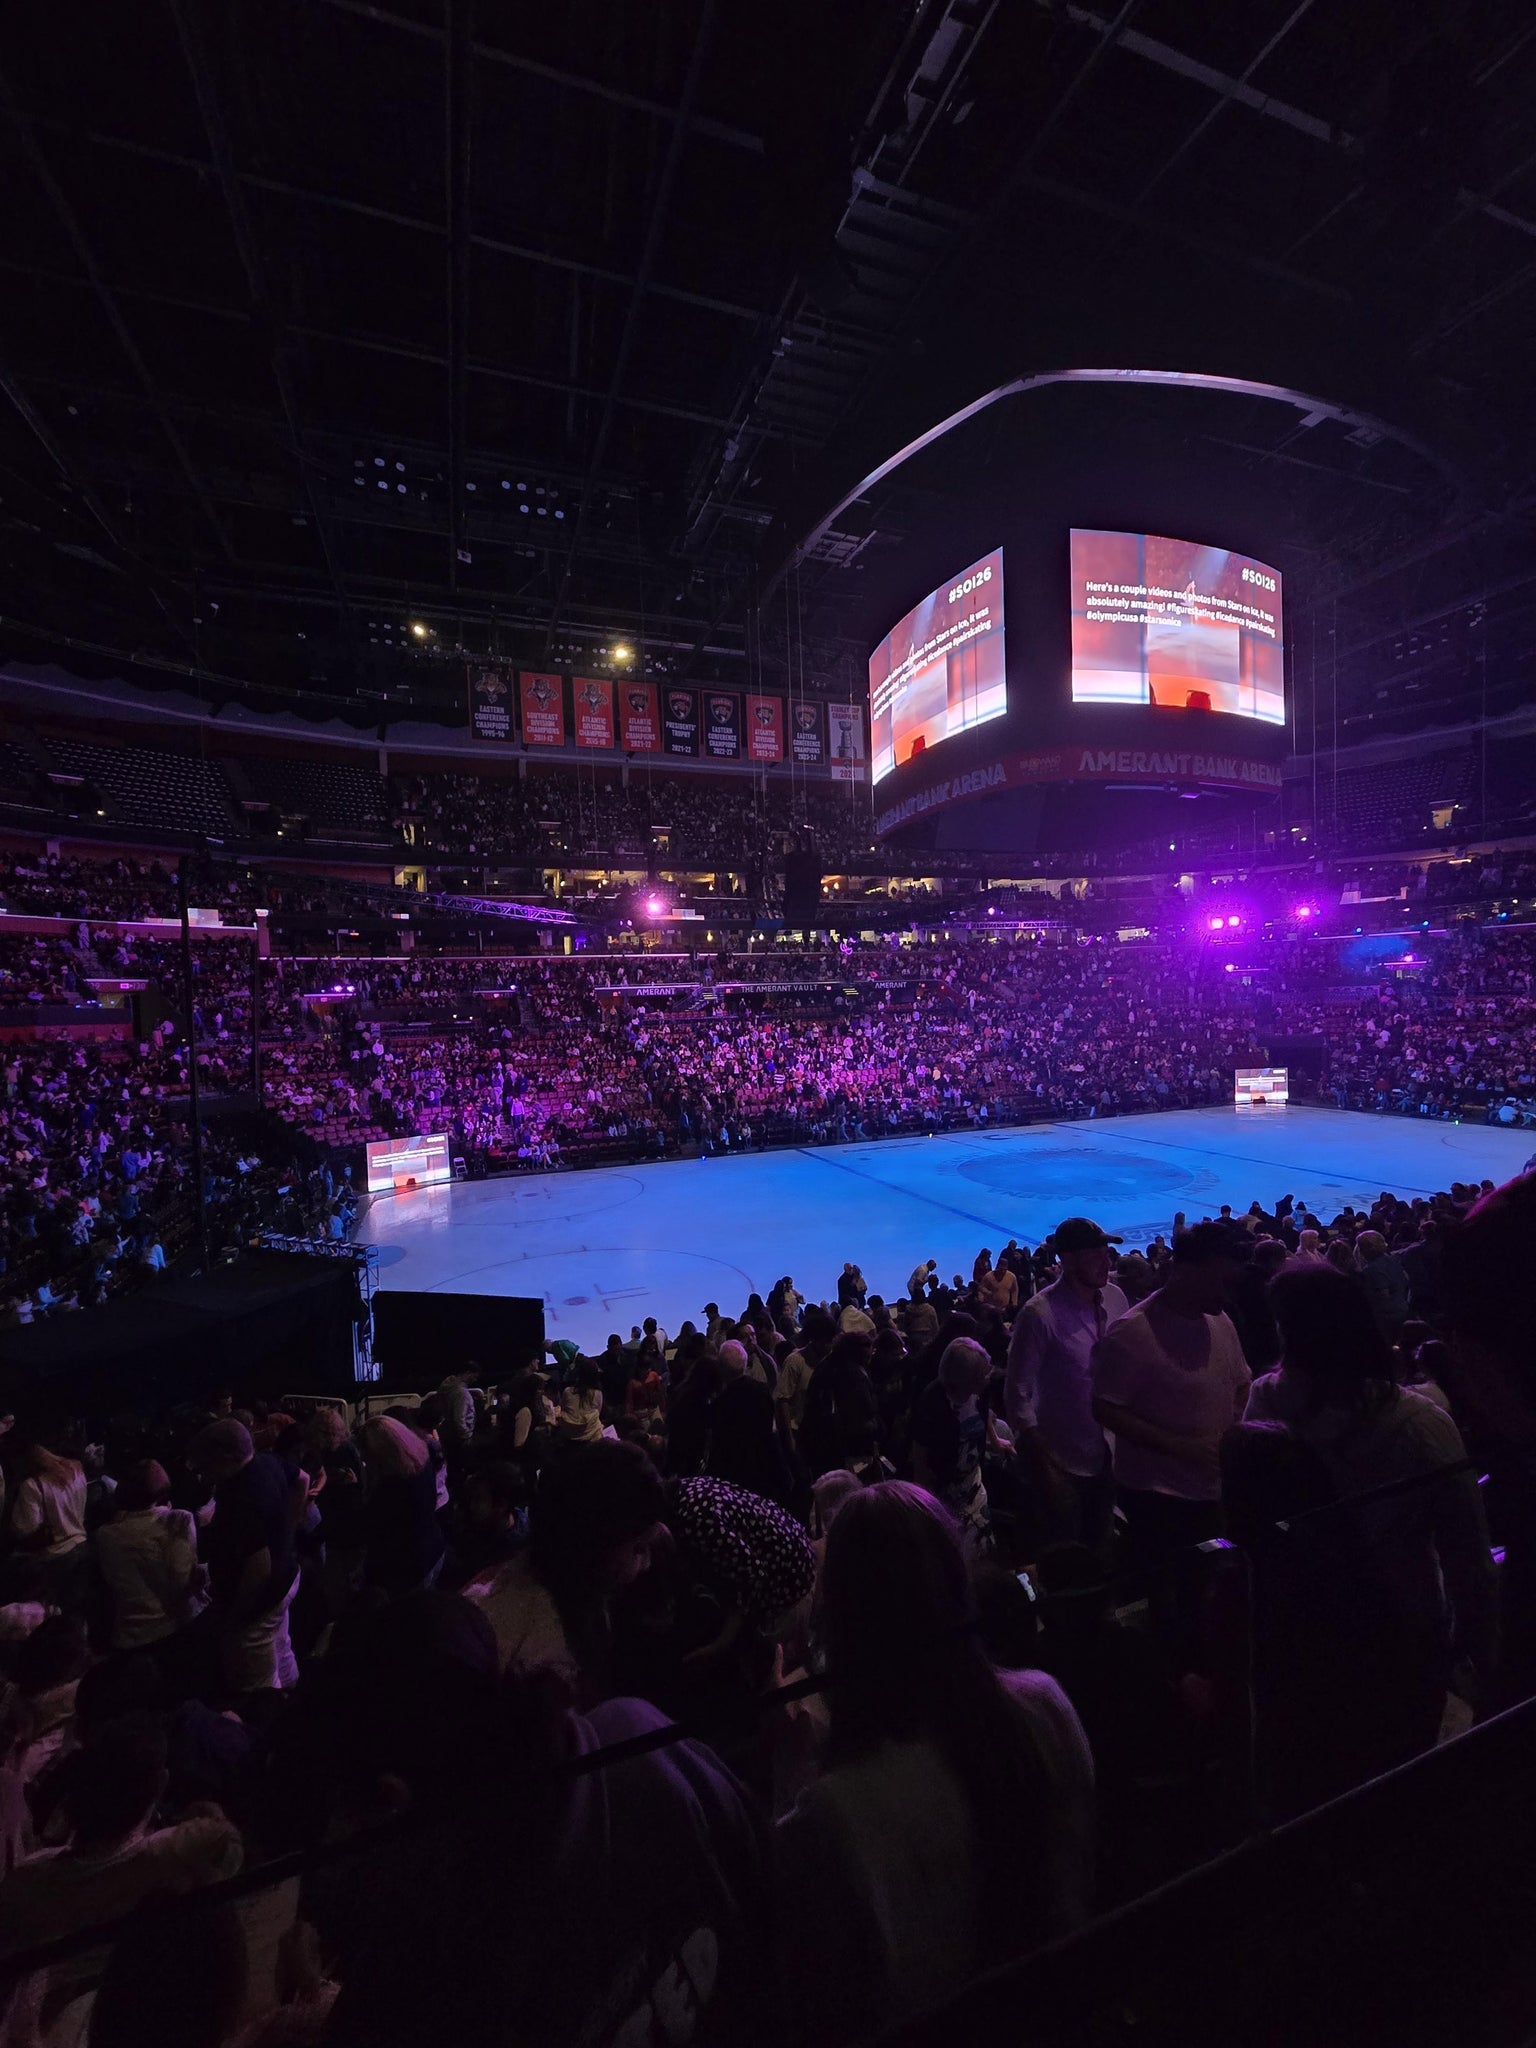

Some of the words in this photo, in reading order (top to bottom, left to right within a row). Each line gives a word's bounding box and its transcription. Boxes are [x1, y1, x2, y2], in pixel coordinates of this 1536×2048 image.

[948, 566, 992, 604] #SOI26
[1242, 567, 1276, 592] #SOI26
[1086, 581, 1113, 592] Here's
[1114, 584, 1119, 592] a
[1120, 585, 1147, 596] couple
[1148, 586, 1172, 597] videos
[1173, 590, 1187, 600] and
[1188, 592, 1211, 604] photos
[1211, 596, 1227, 607] from
[1227, 600, 1242, 612] Stars
[1243, 605, 1250, 614] on
[1086, 595, 1130, 609] absolutely
[1130, 600, 1166, 613] amazing!
[1086, 610, 1138, 623] #olympicusa
[479, 704, 504, 714] EASTERN
[474, 712, 510, 722] CONFERENCE
[475, 720, 510, 730] CHAMPIONS
[1079, 750, 1192, 775] AMERANT
[1192, 755, 1238, 779] BANK
[1239, 761, 1284, 787] ARENA
[917, 782, 951, 812] BANK
[951, 763, 1007, 798] ARENA
[636, 988, 675, 996] AMERANT
[875, 981, 907, 989] AMERANT
